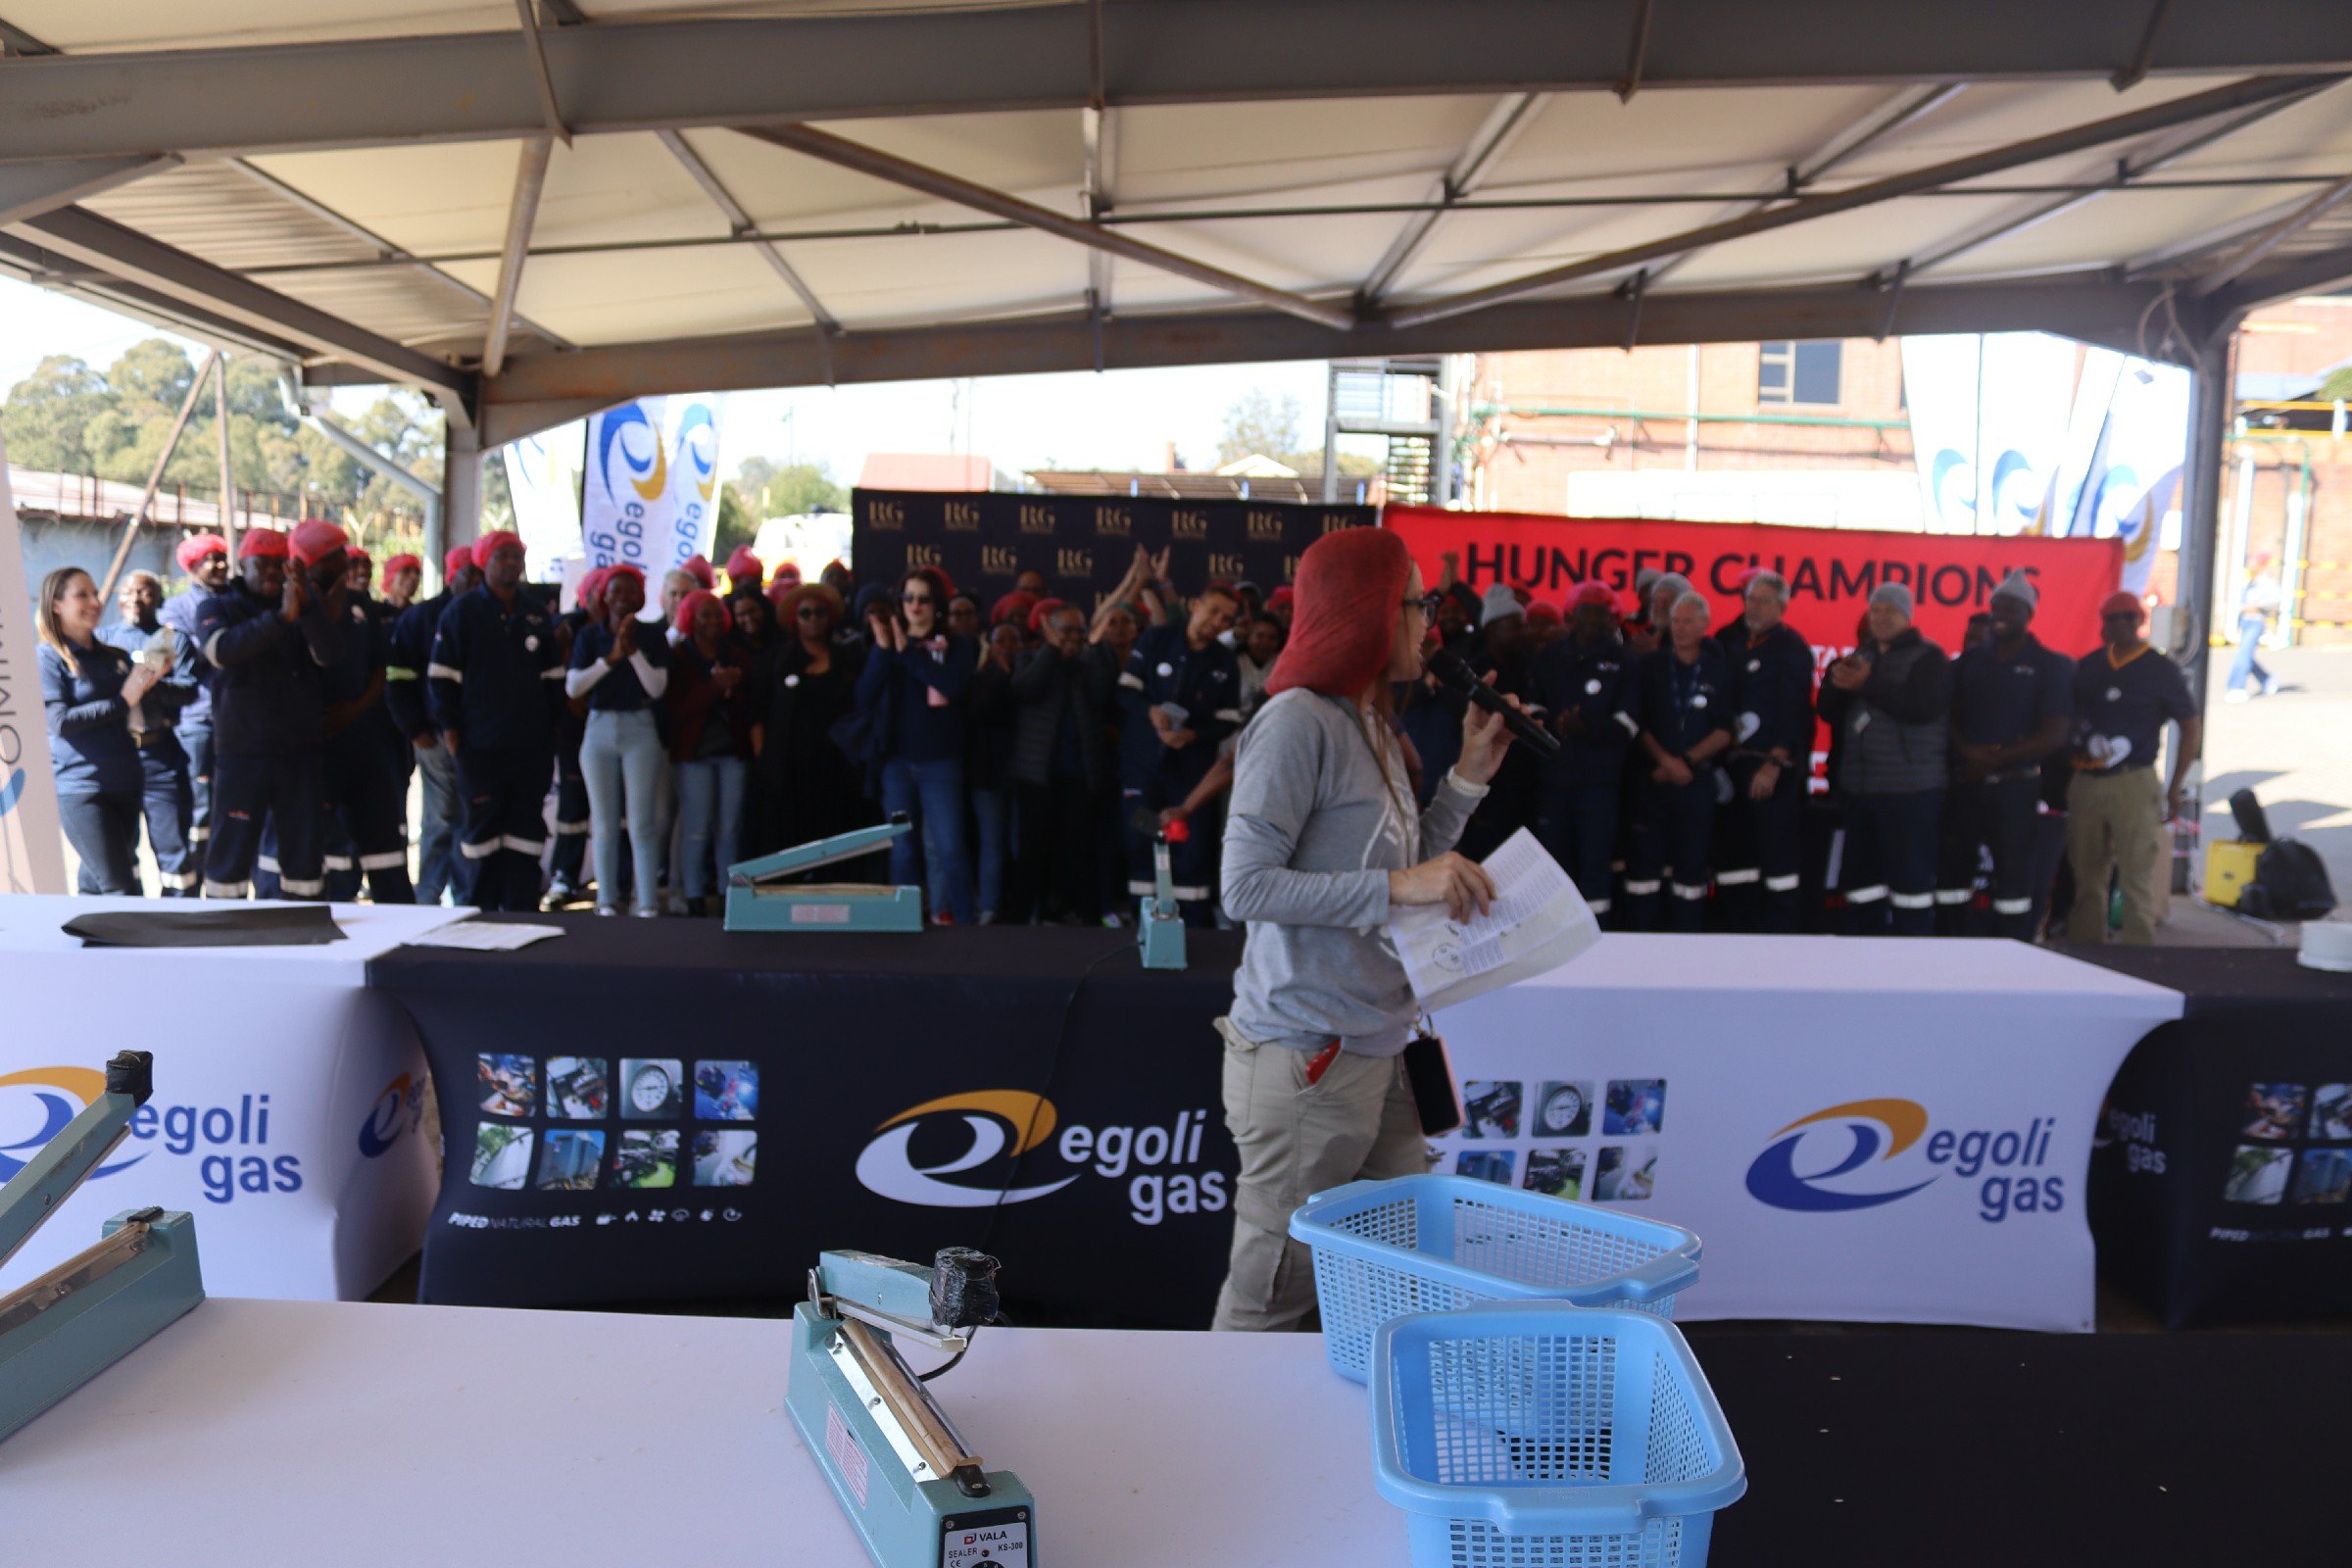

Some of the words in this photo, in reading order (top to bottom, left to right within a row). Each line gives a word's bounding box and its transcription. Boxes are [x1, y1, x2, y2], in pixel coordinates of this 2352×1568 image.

[590, 530, 616, 568] ga
[615, 501, 648, 568] egol
[675, 503, 702, 564] ego
[128, 1094, 270, 1155] egoli
[1058, 1108, 1207, 1178] egoli
[1927, 1116, 2057, 1178] egoli
[201, 1154, 303, 1204] gas
[1129, 1170, 1228, 1225] gas
[1980, 1177, 2065, 1224] gas
[949, 1548, 977, 1558] SEALER
[998, 1542, 1023, 1551] KS-300
[979, 1531, 1007, 1542] VALA
